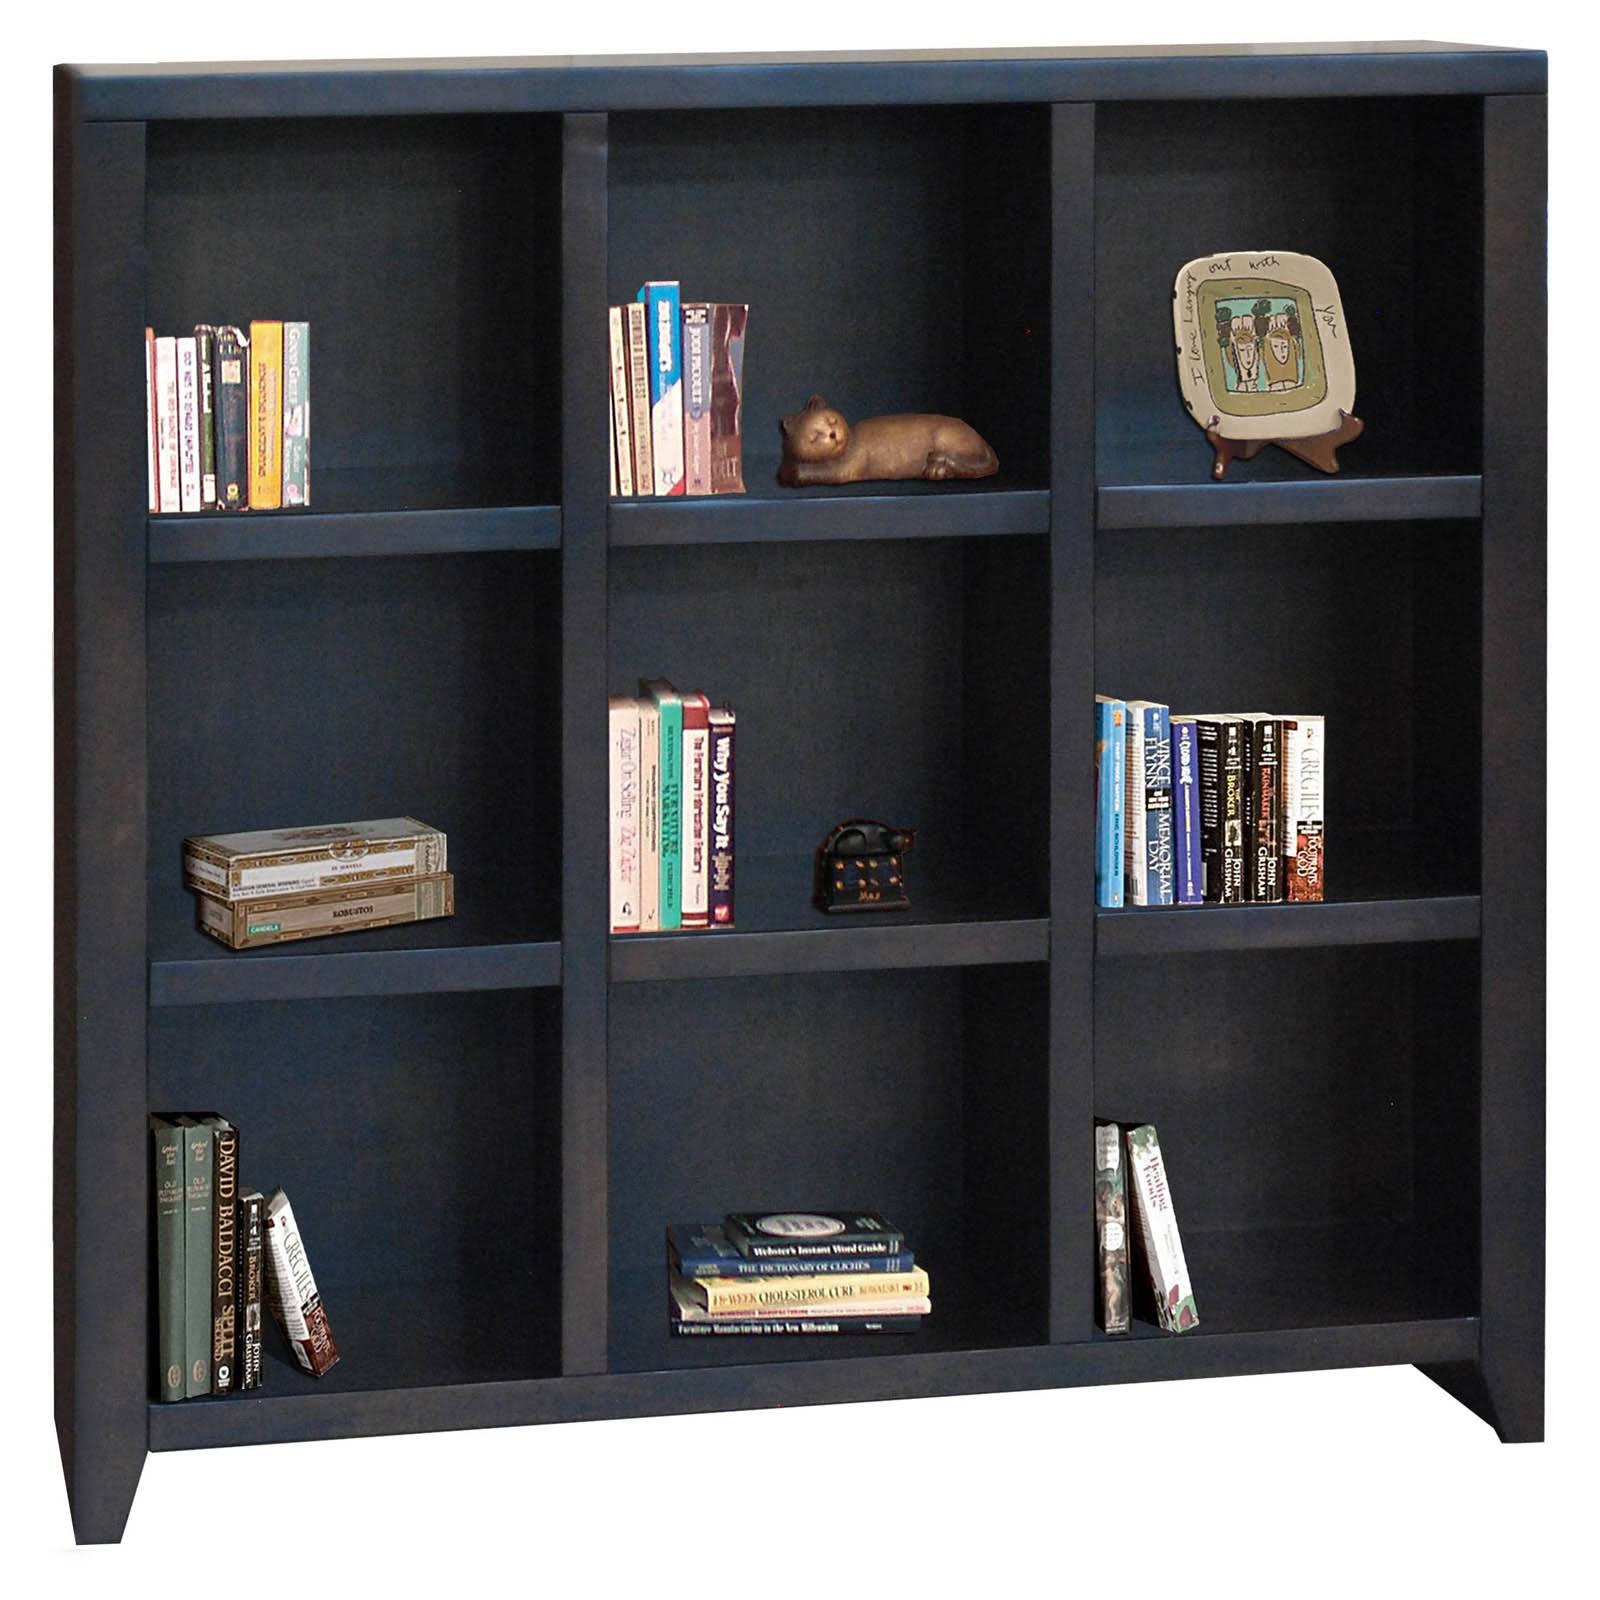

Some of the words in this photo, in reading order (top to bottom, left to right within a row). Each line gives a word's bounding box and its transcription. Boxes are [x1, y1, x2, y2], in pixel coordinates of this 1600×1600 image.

[1191, 368, 1206, 386] I
[1208, 258, 1232, 274] out
[1249, 255, 1280, 270] with
[714, 737, 730, 772] Why
[1145, 737, 1158, 789] FLYNN
[1157, 738, 1170, 785] VINCE
[1300, 748, 1320, 791] GREG
[617, 781, 636, 818] Selling
[714, 771, 729, 804] You
[1226, 775, 1236, 817] BROKER
[1300, 792, 1320, 821] ILES
[670, 783, 678, 854] FURNITURE
[713, 805, 729, 834] Say
[715, 834, 729, 849] It
[1148, 840, 1159, 873] DAY
[1158, 813, 1171, 899] MEMORIAL
[1224, 848, 1234, 897] GRISHAM
[1232, 858, 1242, 887] JOHN
[1258, 846, 1267, 897] GRISHAM
[1267, 856, 1278, 886] JOHN
[1297, 850, 1308, 878] GOD
[250, 924, 279, 934] CANDELA
[332, 904, 374, 918] ROBUSTOS
[220, 1140, 235, 1198] DAVID
[1150, 1156, 1168, 1211] Healing
[218, 1204, 234, 1298] BALDACCI
[283, 1232, 308, 1278] GREG
[738, 1262, 757, 1274] THE
[759, 1262, 816, 1274] DICTIONARY
[816, 1262, 829, 1272] OF
[754, 1246, 796, 1256] Webster's
[798, 1246, 831, 1255] Instant
[832, 1244, 857, 1254] Word
[858, 1242, 887, 1252] Guide
[248, 1255, 257, 1302] BROKER
[758, 1287, 827, 1304] CHOLESTEROL
[828, 1285, 854, 1299] CURE
[214, 1316, 223, 1362] SECOND
[222, 1304, 234, 1358] SPLIT
[772, 1323, 784, 1333] the
[245, 1334, 254, 1384] GRISHAM
[252, 1342, 261, 1372] JOHN
